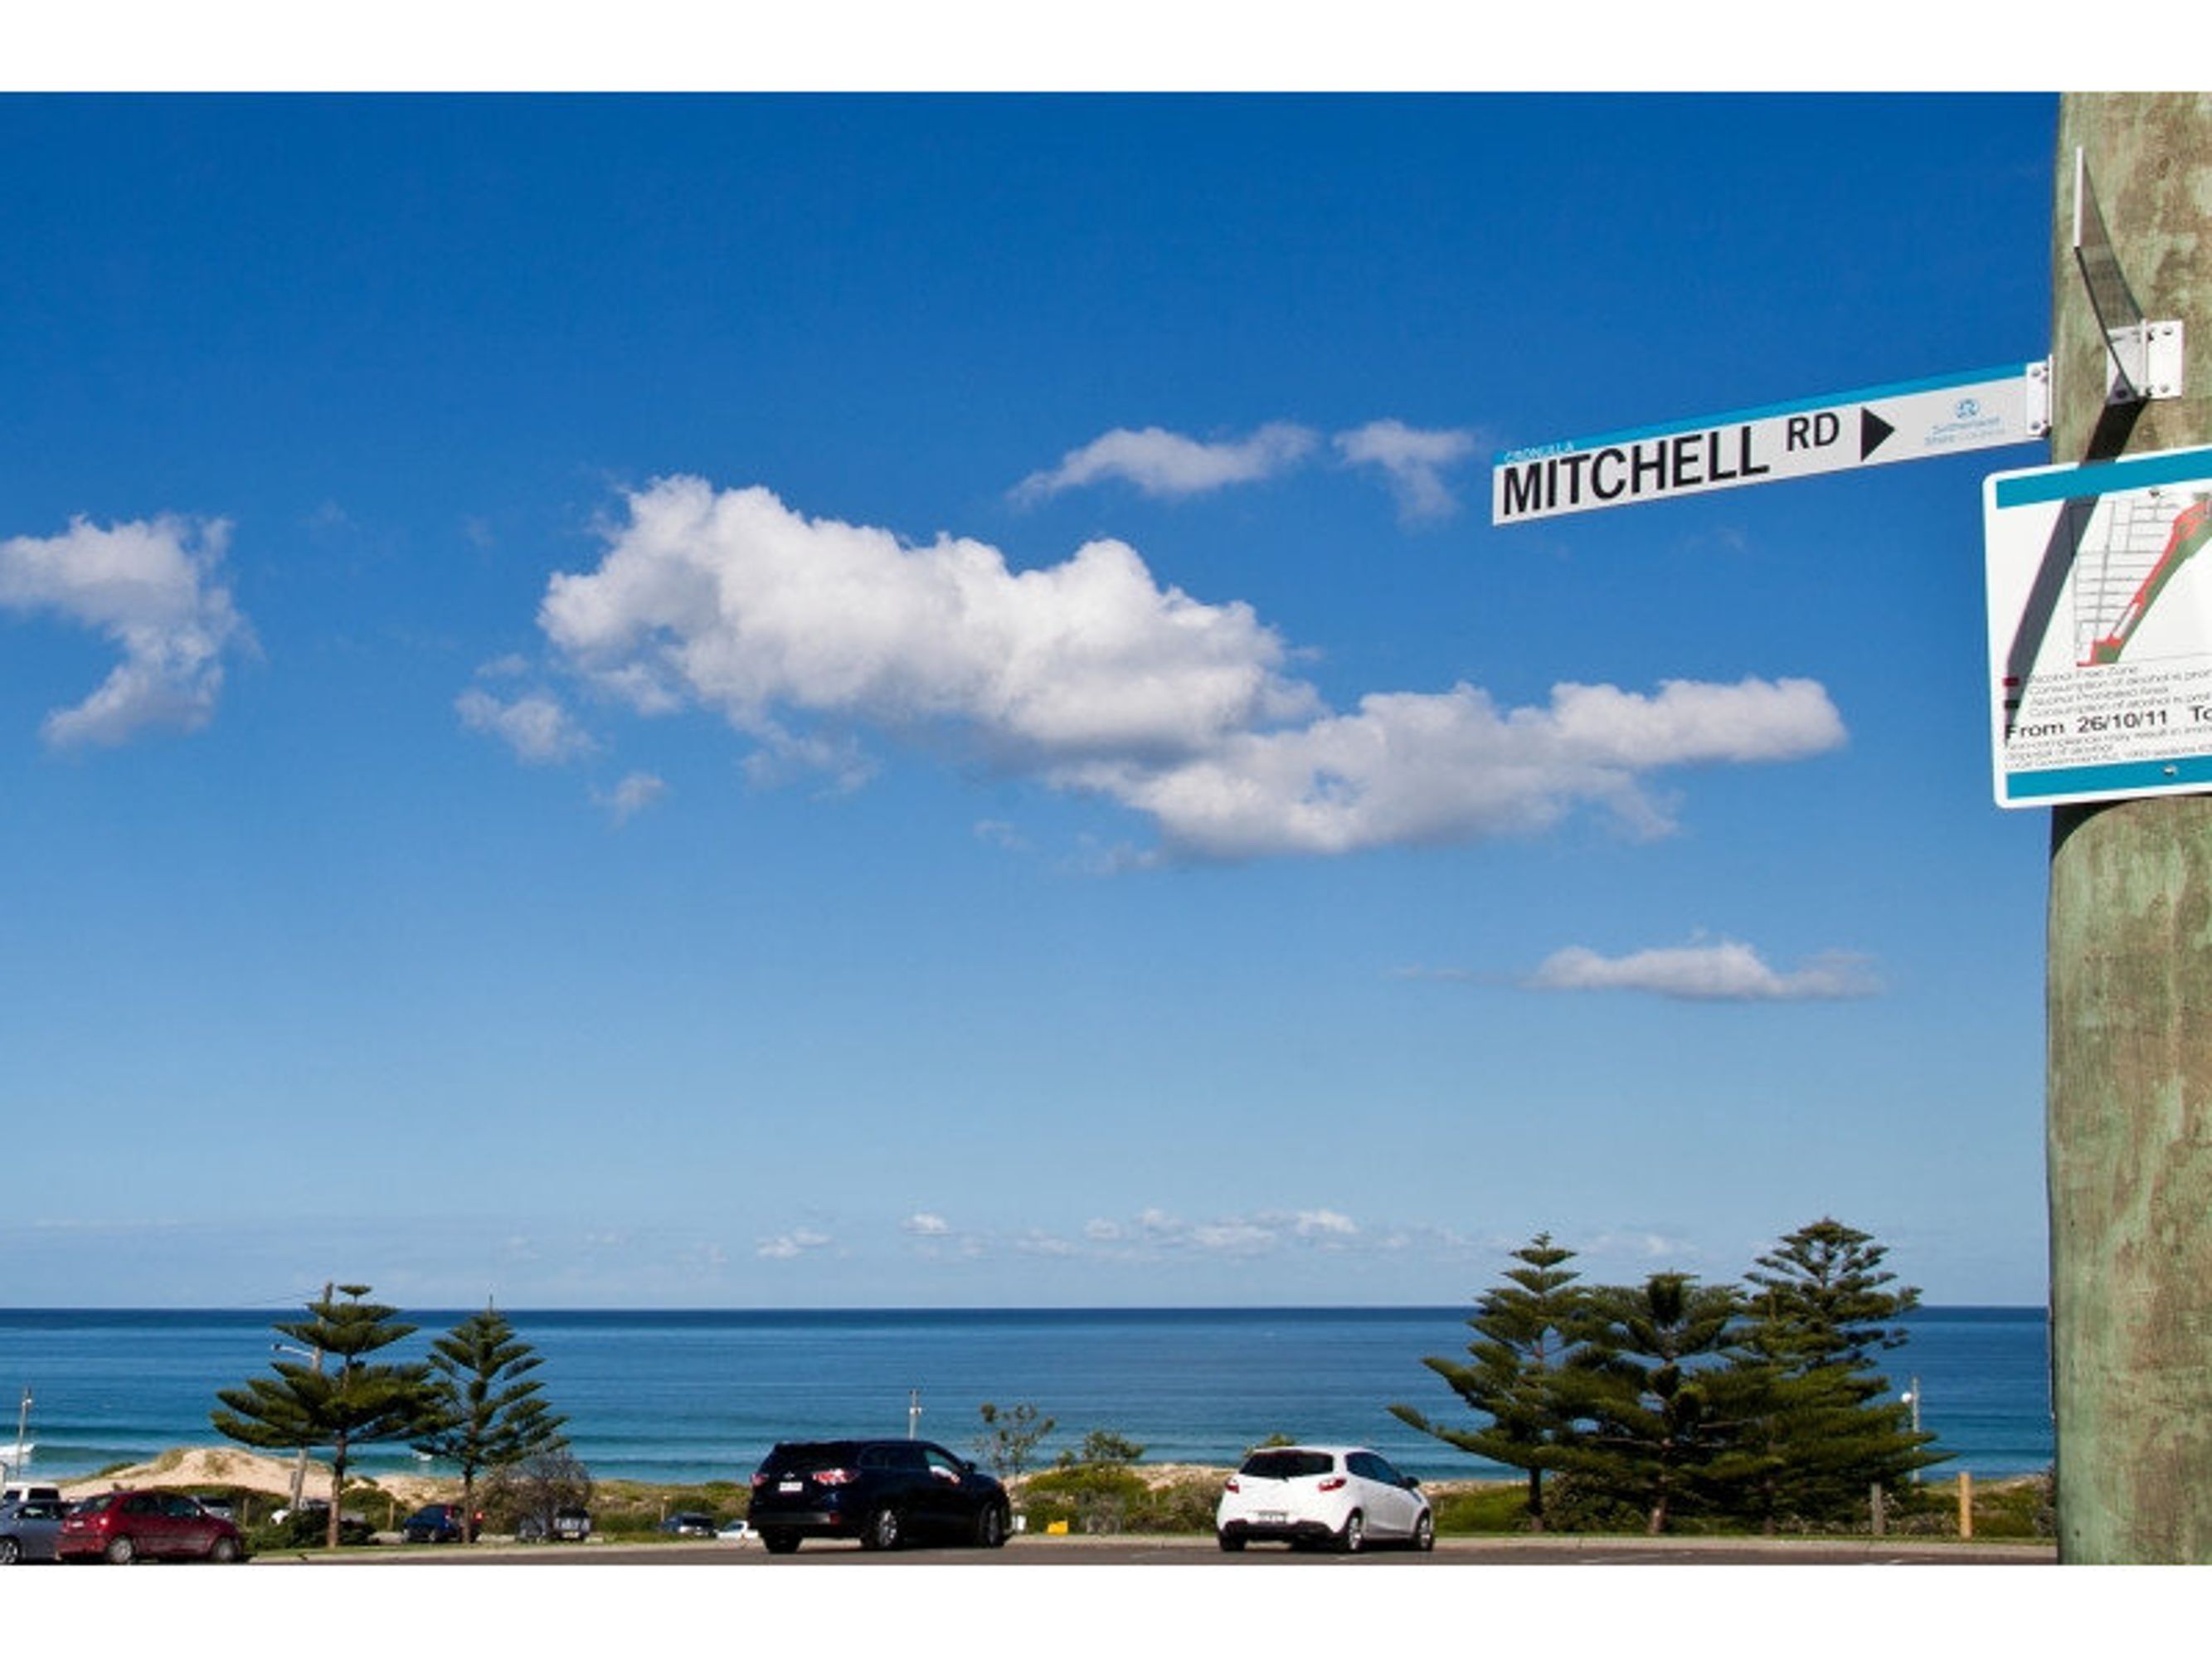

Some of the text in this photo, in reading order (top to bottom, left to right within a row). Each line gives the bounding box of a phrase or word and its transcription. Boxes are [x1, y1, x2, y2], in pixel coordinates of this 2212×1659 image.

[1502, 411, 1840, 516] MITCHELL RD
[2005, 722, 2065, 739] From
[2076, 709, 2167, 733] 26/10/11
